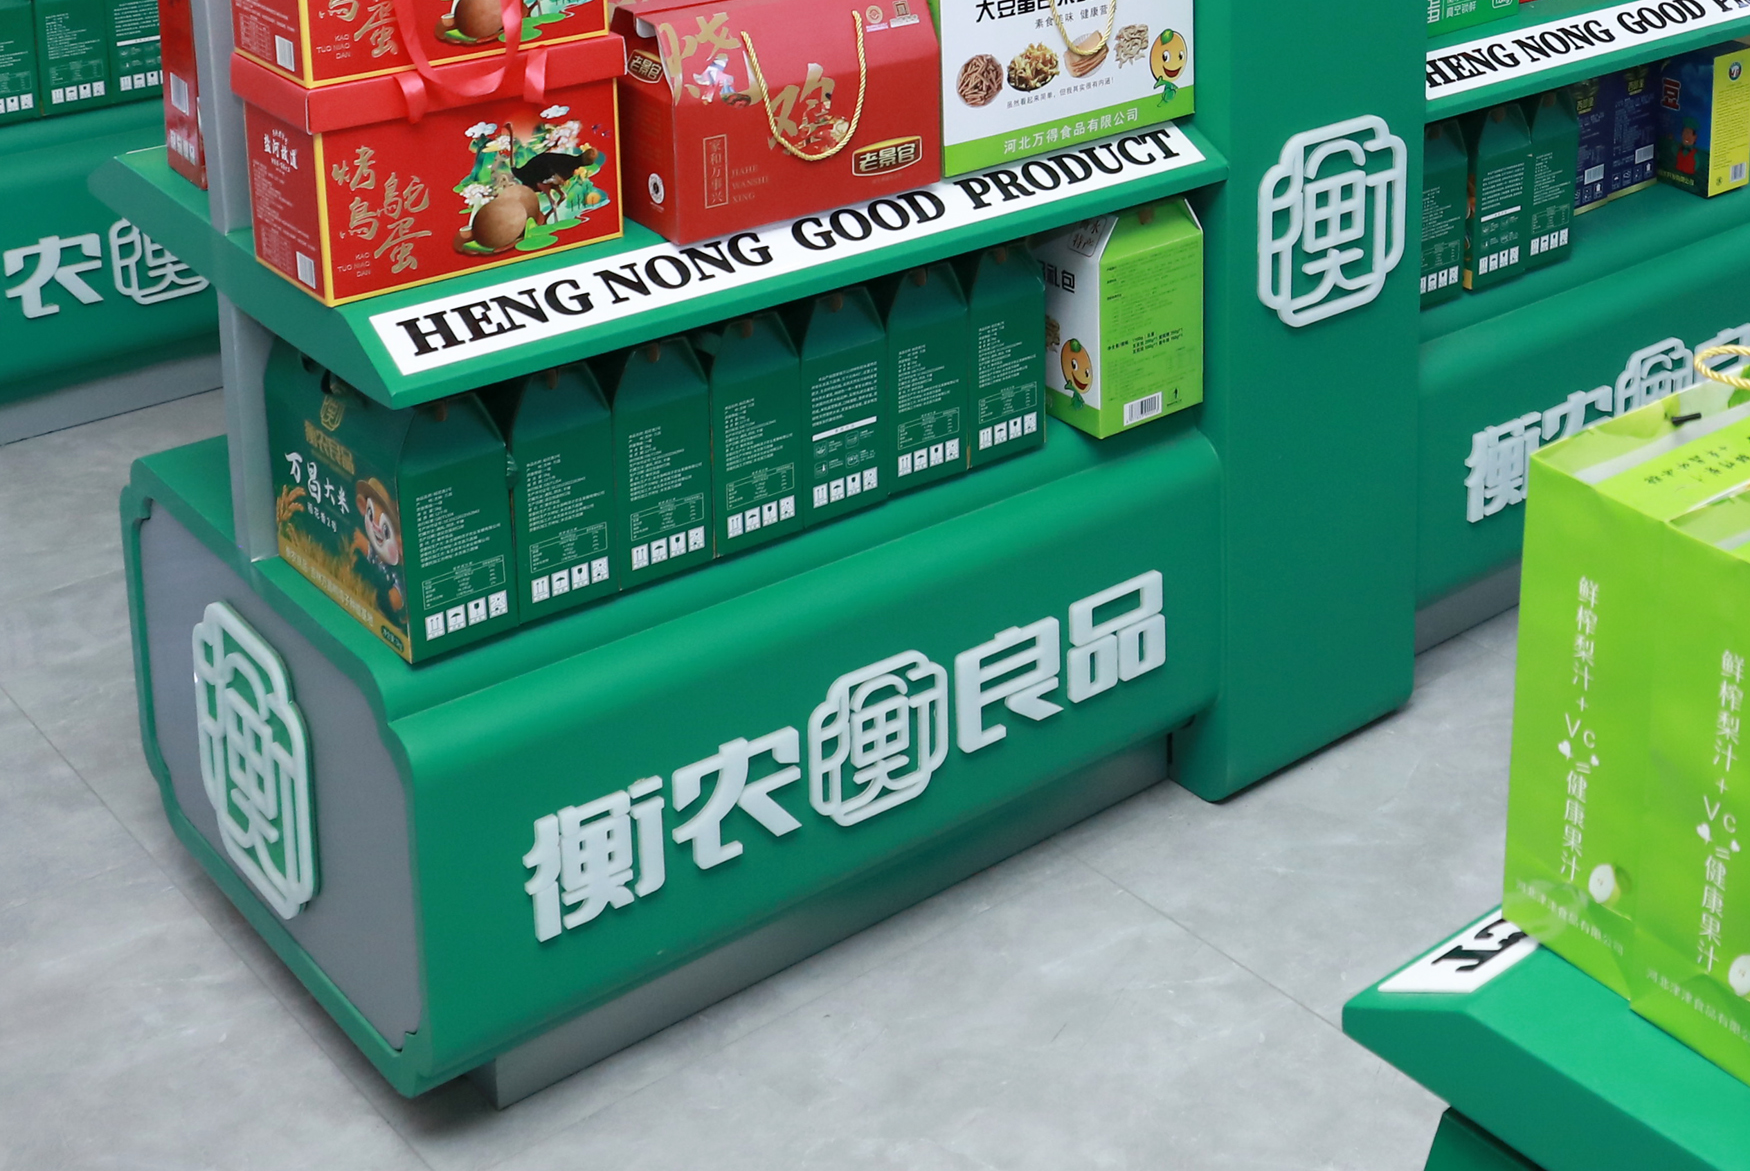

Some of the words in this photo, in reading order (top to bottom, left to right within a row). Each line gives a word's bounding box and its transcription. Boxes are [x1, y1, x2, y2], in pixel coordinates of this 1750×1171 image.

[1426, 41, 1521, 89] HENG
[1514, 18, 1615, 64] NONG
[858, 143, 917, 172] 老景官
[1003, 107, 1139, 155] 河北万得食品有限公司
[397, 278, 596, 356] HENG
[593, 230, 775, 305] NONG
[791, 188, 946, 251] GOOD
[954, 128, 1181, 210] PRODUCT
[285, 451, 350, 515] 万昌大米
